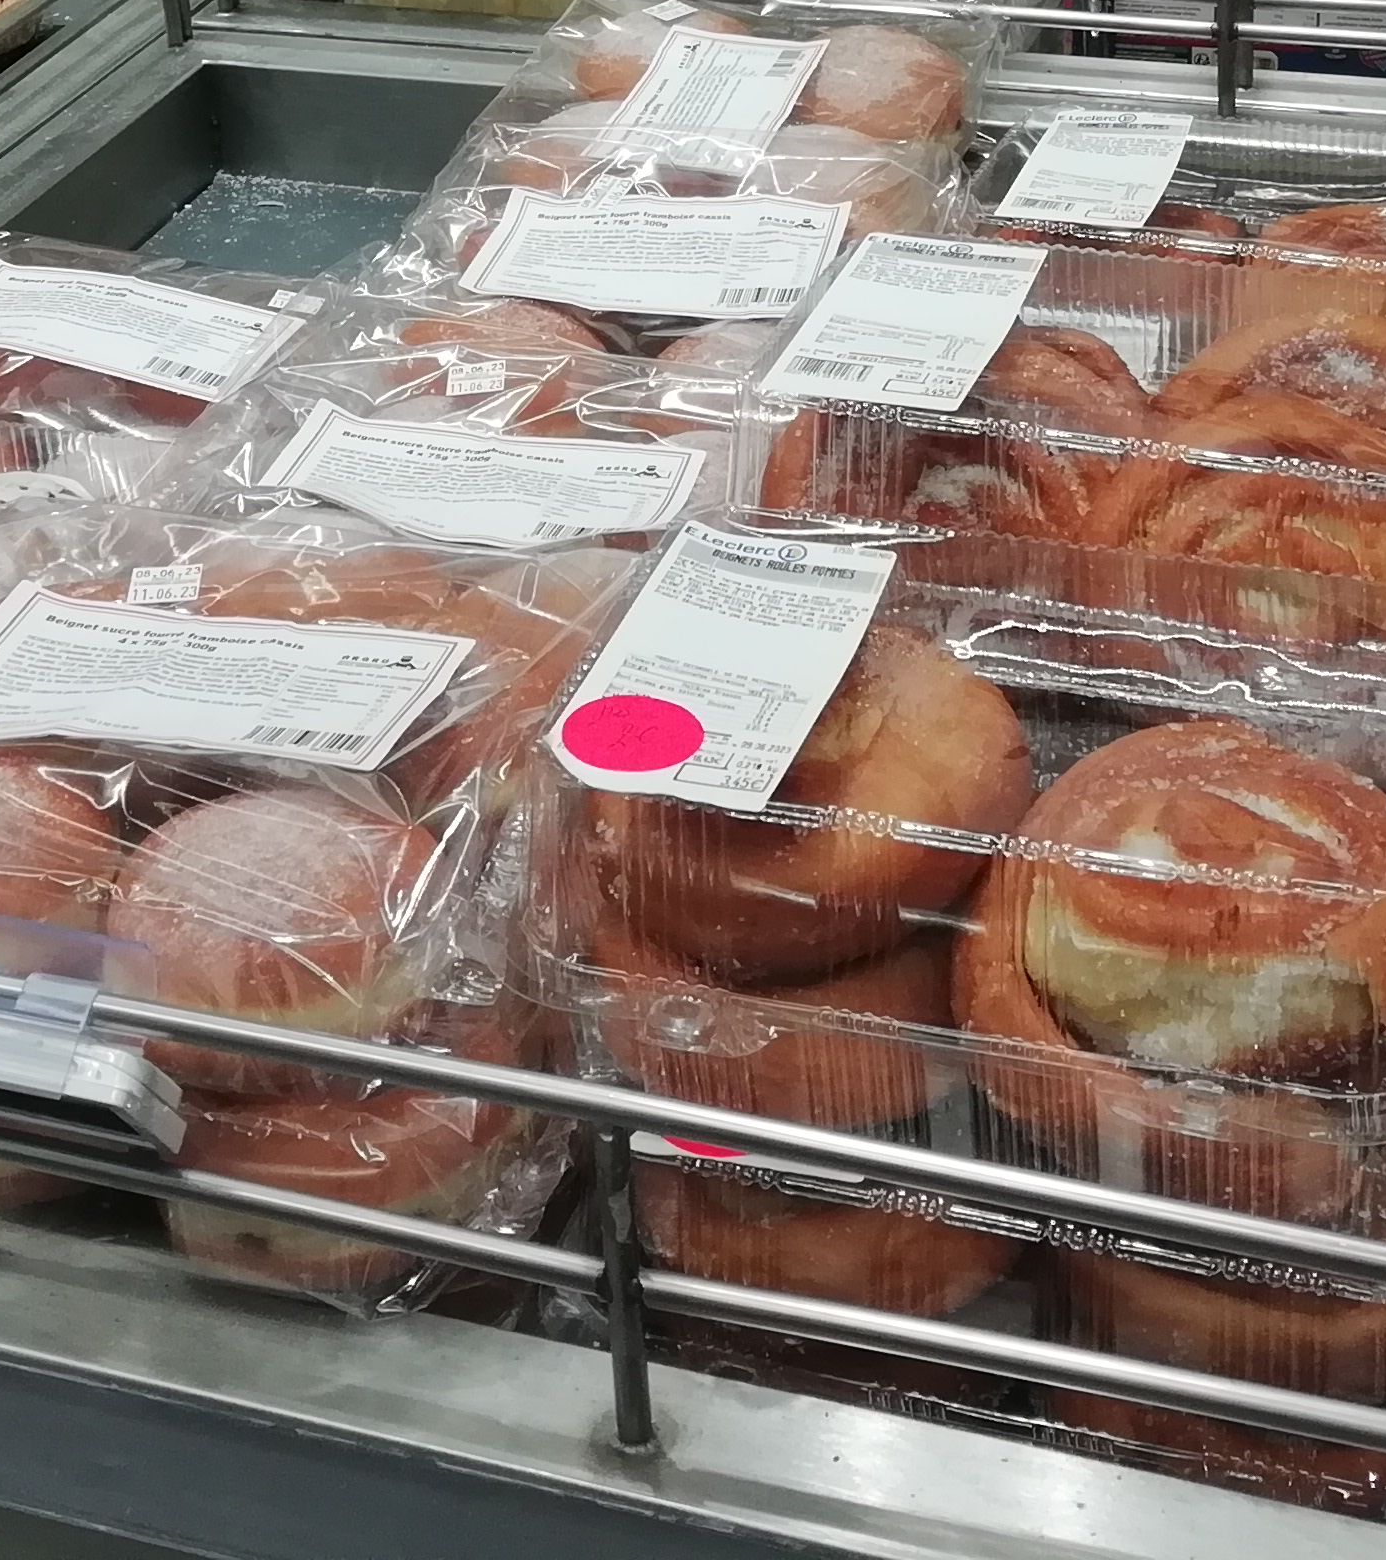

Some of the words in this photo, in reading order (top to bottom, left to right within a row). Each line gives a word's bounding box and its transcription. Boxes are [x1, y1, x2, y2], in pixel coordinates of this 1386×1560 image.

[449, 378, 503, 393] 11.06.23
[342, 430, 389, 445] Beignet
[526, 454, 565, 464] cassis
[427, 452, 449, 462] 75g
[712, 548, 764, 568] BEIGNETS
[811, 565, 857, 580] POMMES
[132, 585, 199, 603] 11.06.23
[45, 613, 100, 633] Beignet
[102, 622, 141, 638] sucré
[188, 631, 258, 646] framboise
[260, 636, 305, 652] cassis
[143, 638, 168, 648] 75g
[183, 640, 217, 654] 300g
